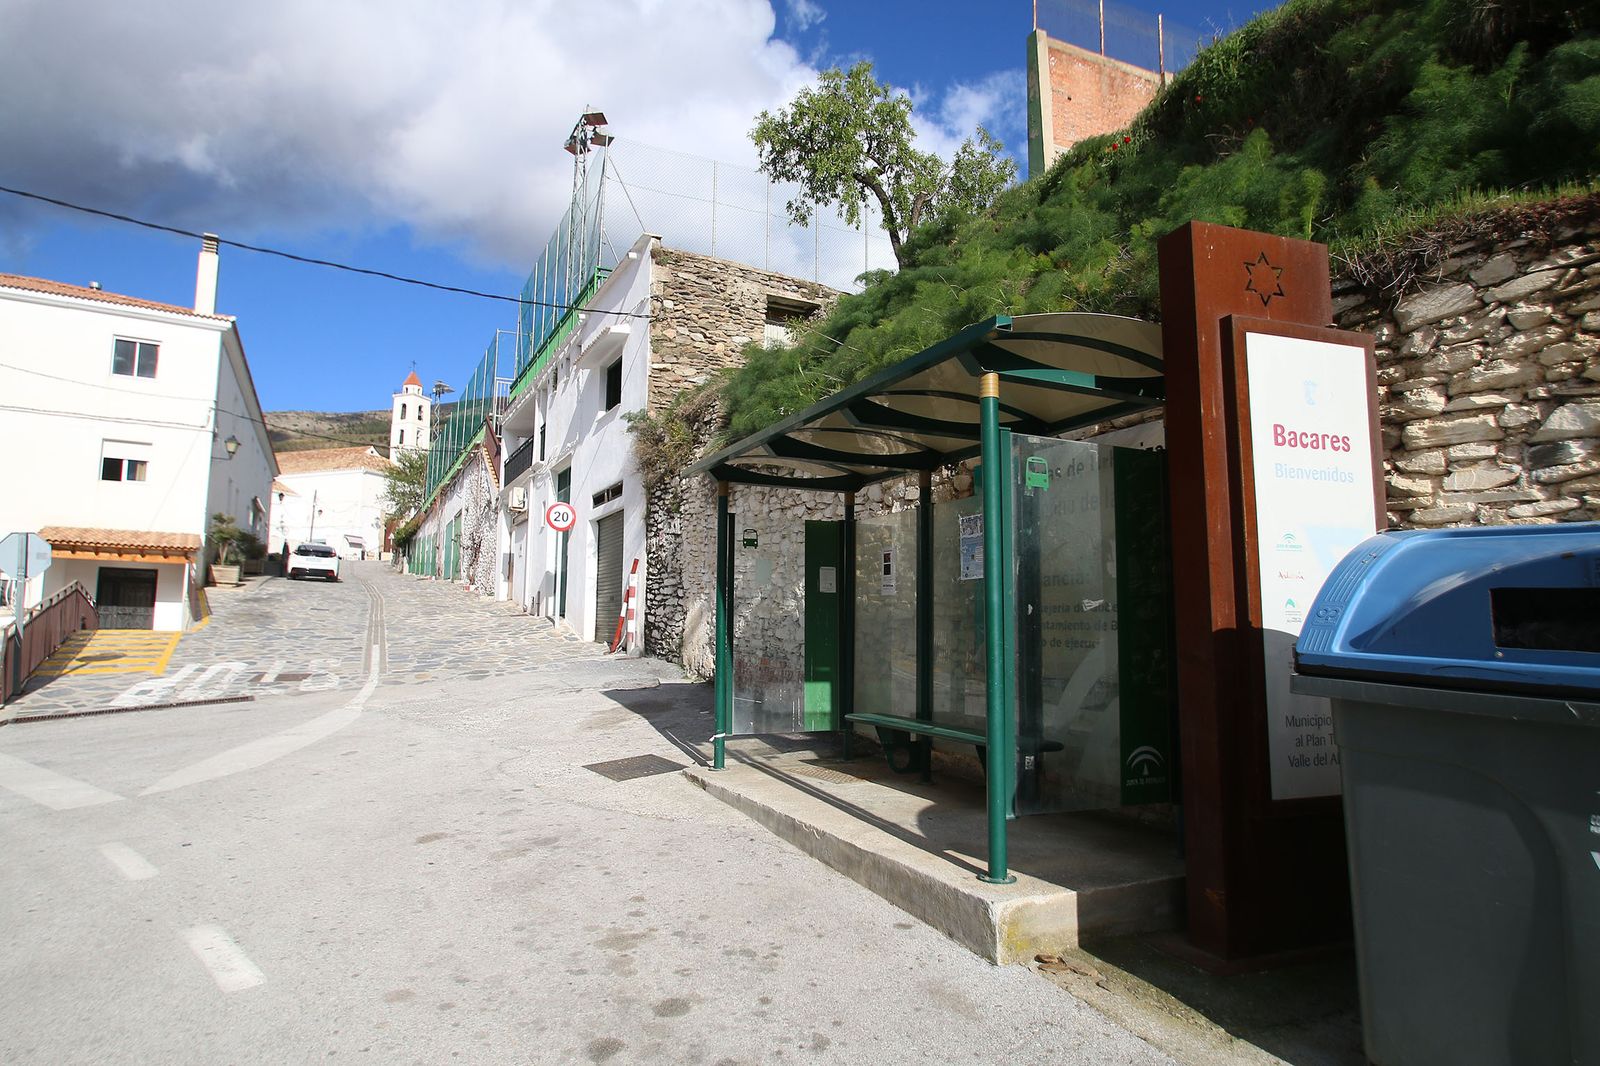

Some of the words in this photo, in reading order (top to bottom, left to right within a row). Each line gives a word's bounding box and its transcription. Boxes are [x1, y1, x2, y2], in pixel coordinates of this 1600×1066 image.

[1273, 423, 1351, 452] Bacares
[1274, 463, 1354, 484] Bienvenidos
[553, 511, 569, 522] 20
[1285, 714, 1332, 729] Municipio
[1295, 734, 1303, 747] al
[1306, 734, 1326, 746] Plan
[1288, 754, 1311, 768] Valle
[1313, 753, 1327, 766] del
